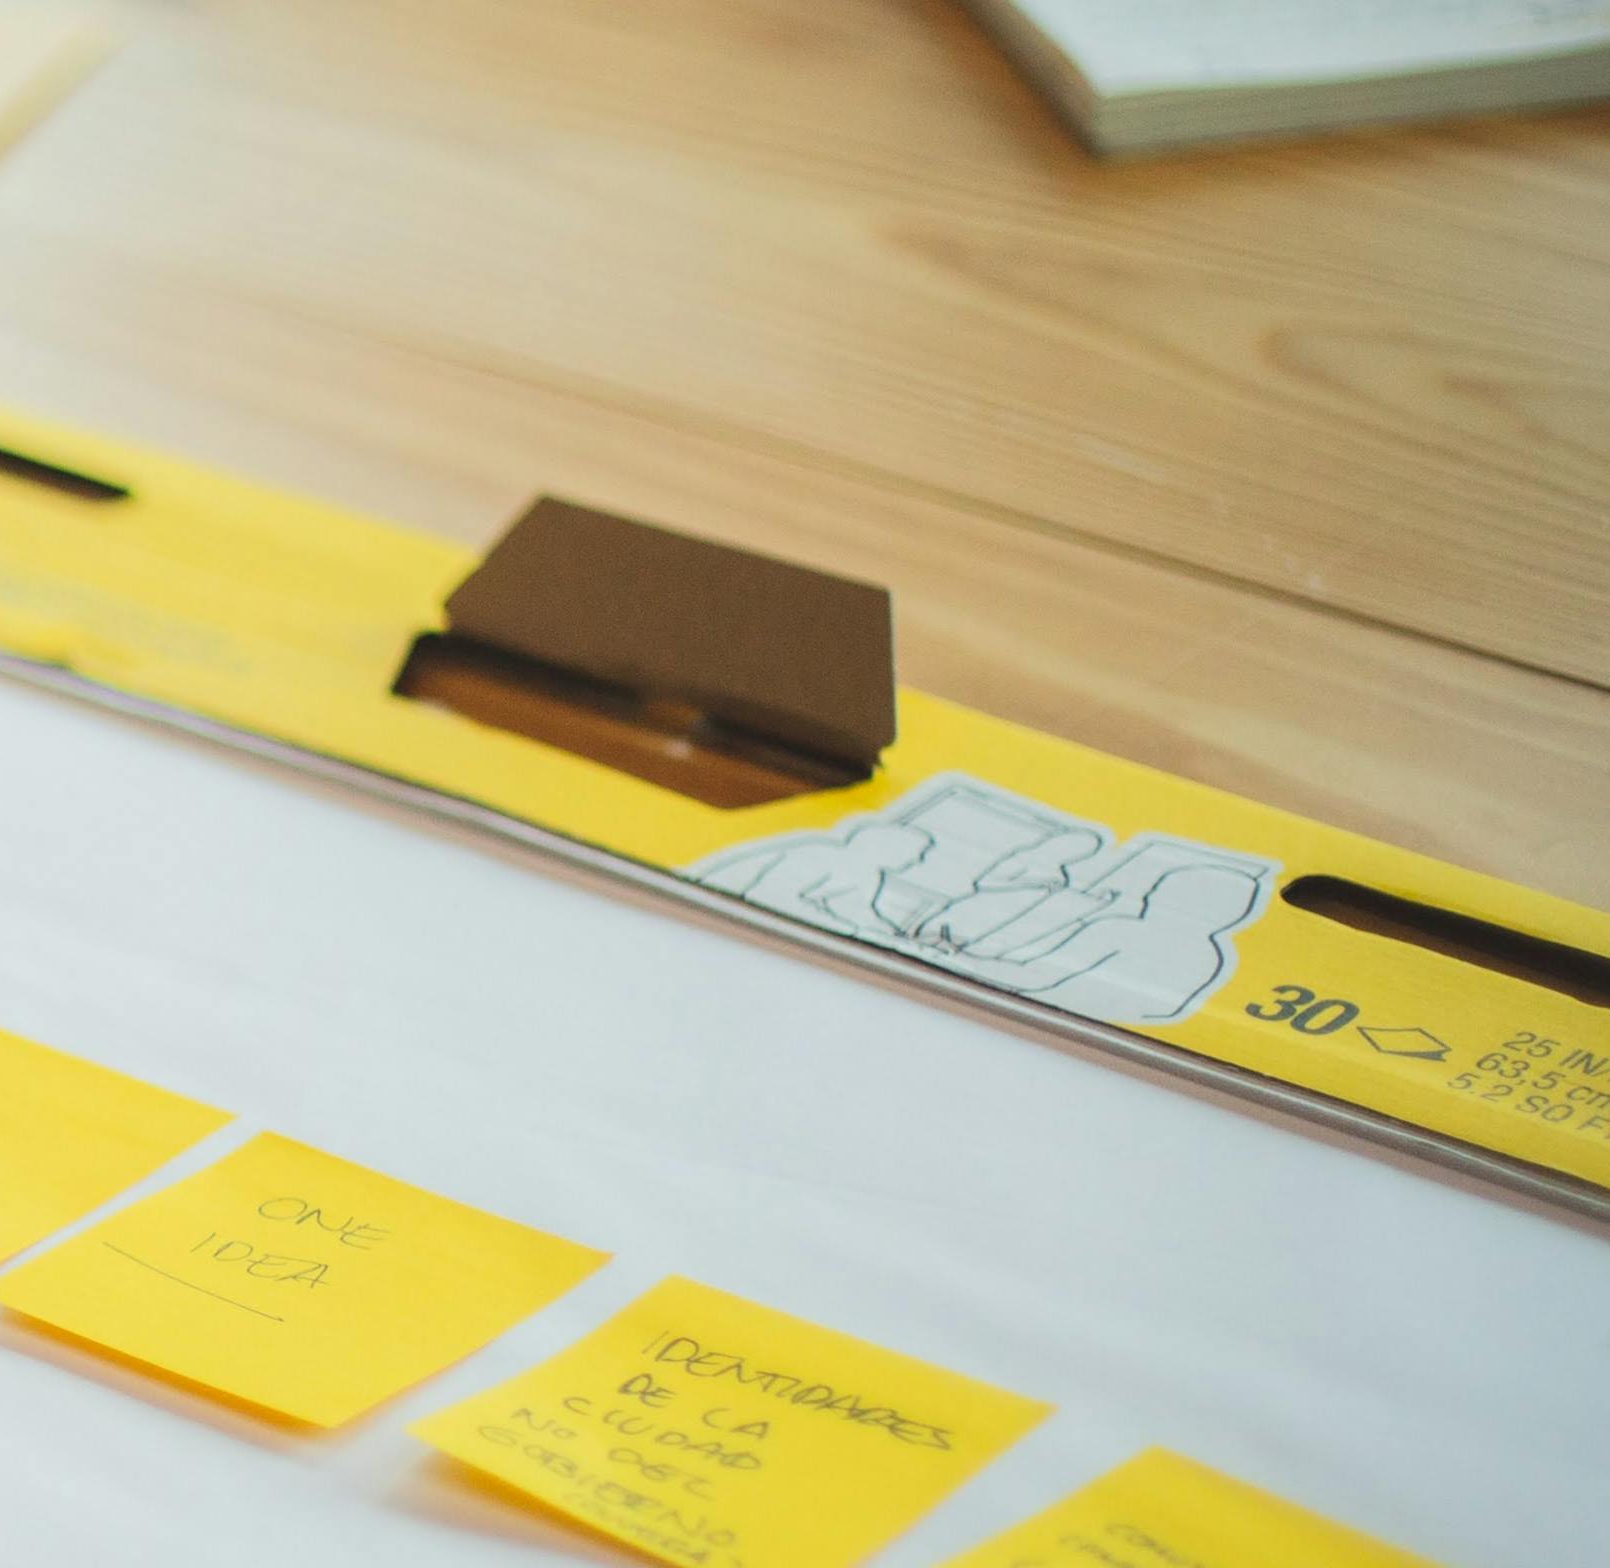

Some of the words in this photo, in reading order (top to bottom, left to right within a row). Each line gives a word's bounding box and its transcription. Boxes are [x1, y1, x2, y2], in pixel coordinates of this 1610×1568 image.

[1245, 985, 1359, 1035] 30
[1502, 1032, 1562, 1058] 25
[1558, 1048, 1610, 1084] IN/
[1447, 1072, 1515, 1104] 5.2
[257, 1197, 392, 1252] ONE
[189, 1231, 330, 1289] IDEA
[618, 1372, 677, 1409] DE
[561, 1396, 763, 1471] CIUDAD
